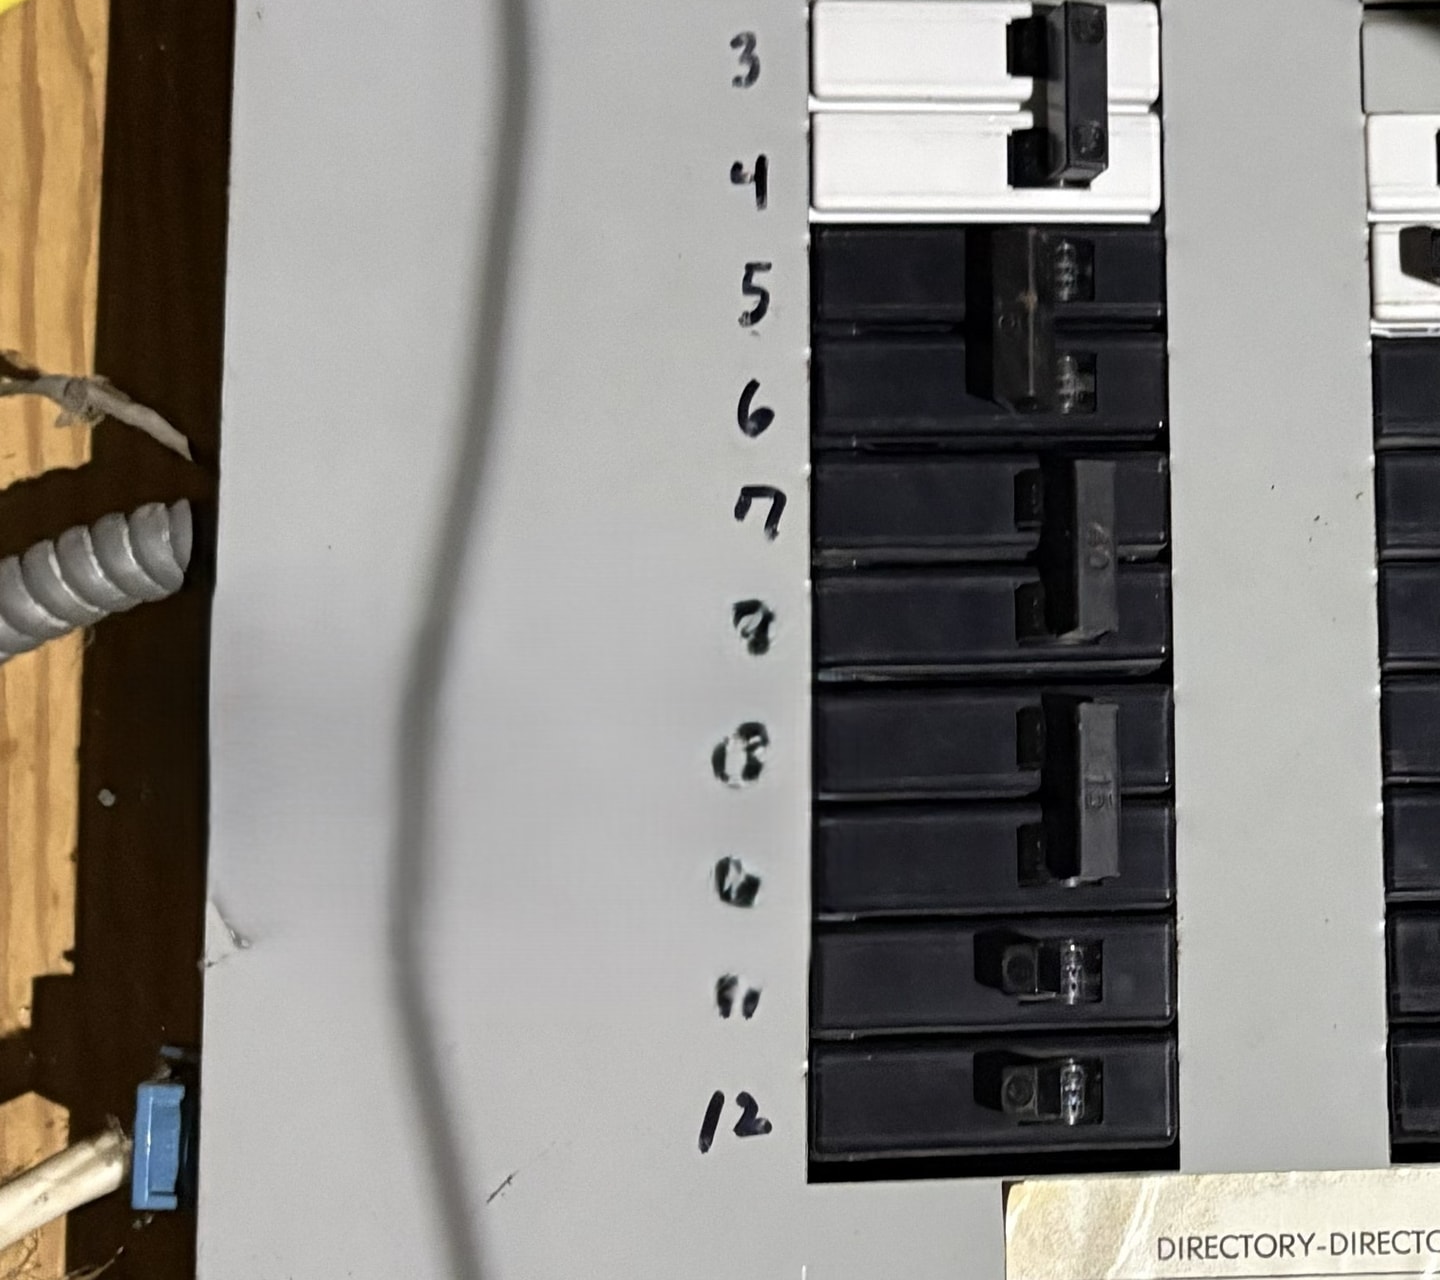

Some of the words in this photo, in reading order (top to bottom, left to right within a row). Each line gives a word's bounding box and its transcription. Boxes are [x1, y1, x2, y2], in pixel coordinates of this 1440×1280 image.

[730, 31, 760, 88] 3
[730, 153, 769, 211] 4
[738, 261, 773, 328] 5
[737, 378, 775, 438] 6
[733, 485, 787, 541] 7
[698, 1090, 772, 1154] 12
